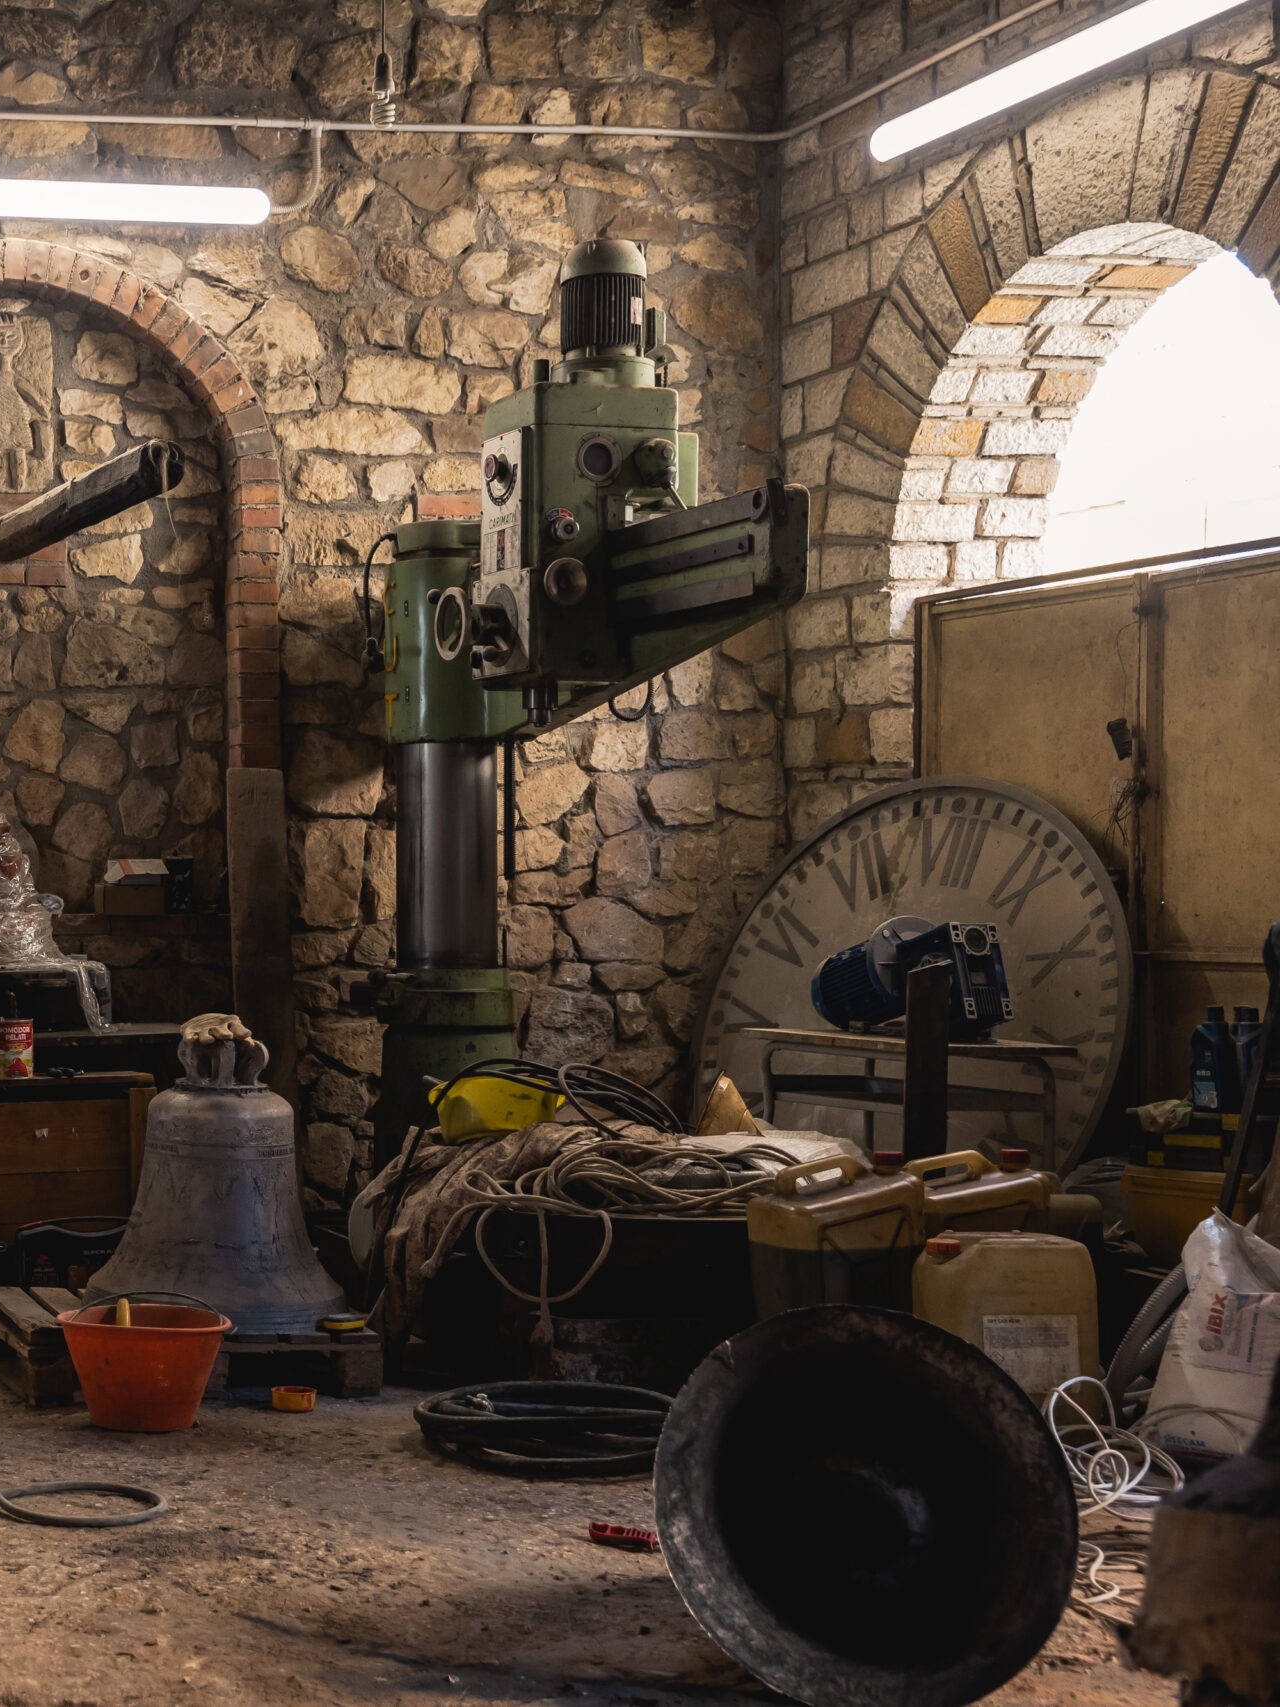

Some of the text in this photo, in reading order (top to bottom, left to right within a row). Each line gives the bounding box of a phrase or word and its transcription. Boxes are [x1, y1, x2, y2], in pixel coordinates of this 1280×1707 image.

[826, 831, 891, 912] VII
[920, 817, 991, 890] VIII
[987, 840, 1062, 927] IX
[756, 905, 821, 968] VI
[1026, 924, 1096, 988] X
[5, 1033, 27, 1041] PELATI
[1206, 1293, 1228, 1335] IBIX
